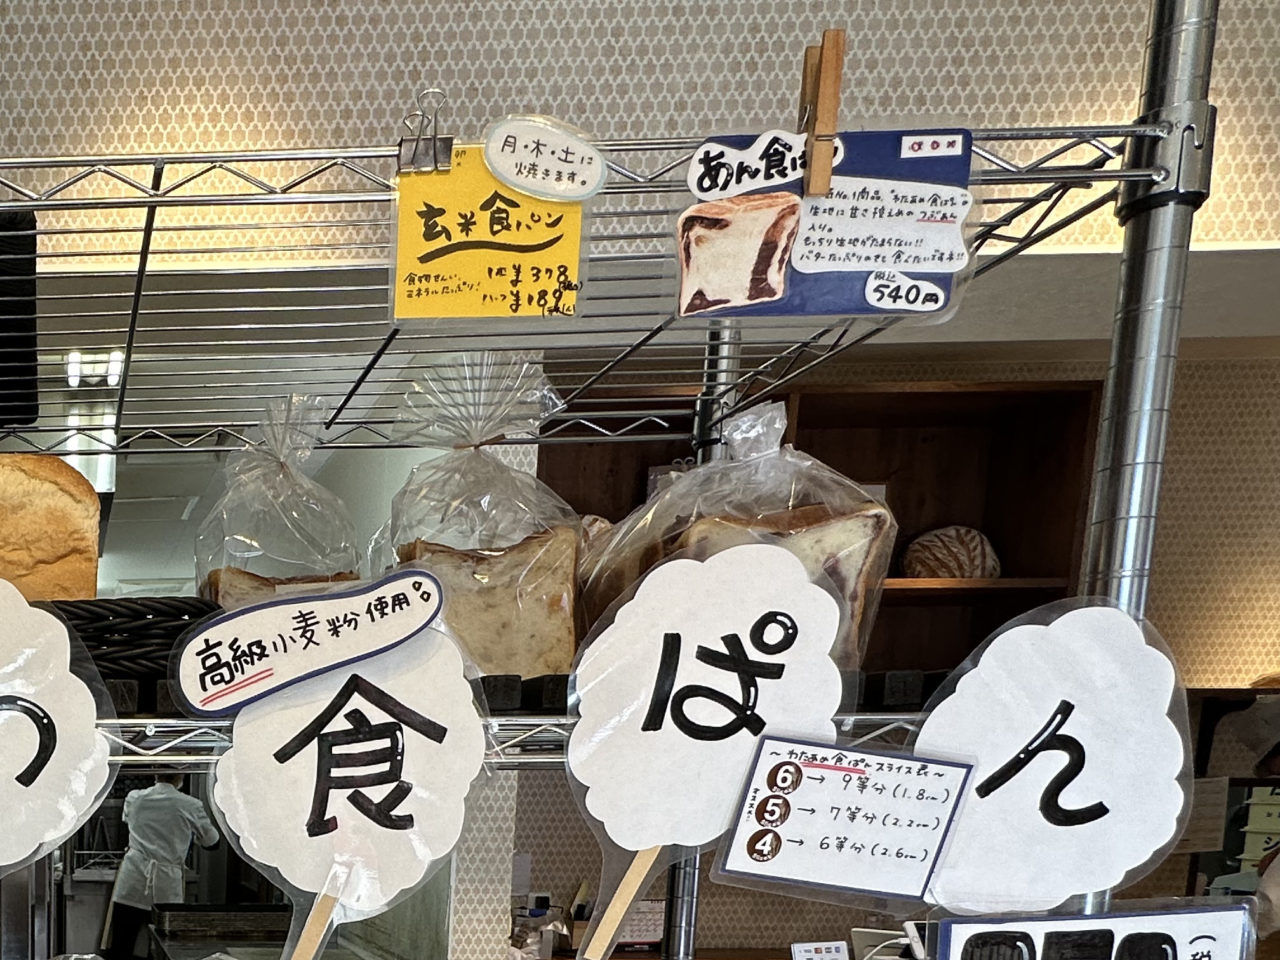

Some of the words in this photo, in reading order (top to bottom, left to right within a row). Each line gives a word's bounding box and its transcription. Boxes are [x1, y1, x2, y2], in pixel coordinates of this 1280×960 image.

[415, 190, 564, 242] 玄米食パン
[873, 284, 940, 305] 540円
[195, 592, 411, 692] 高級小麦粉使用
[272, 672, 449, 837] 食
[642, 610, 800, 742] ぱ
[975, 700, 1110, 827] ん
